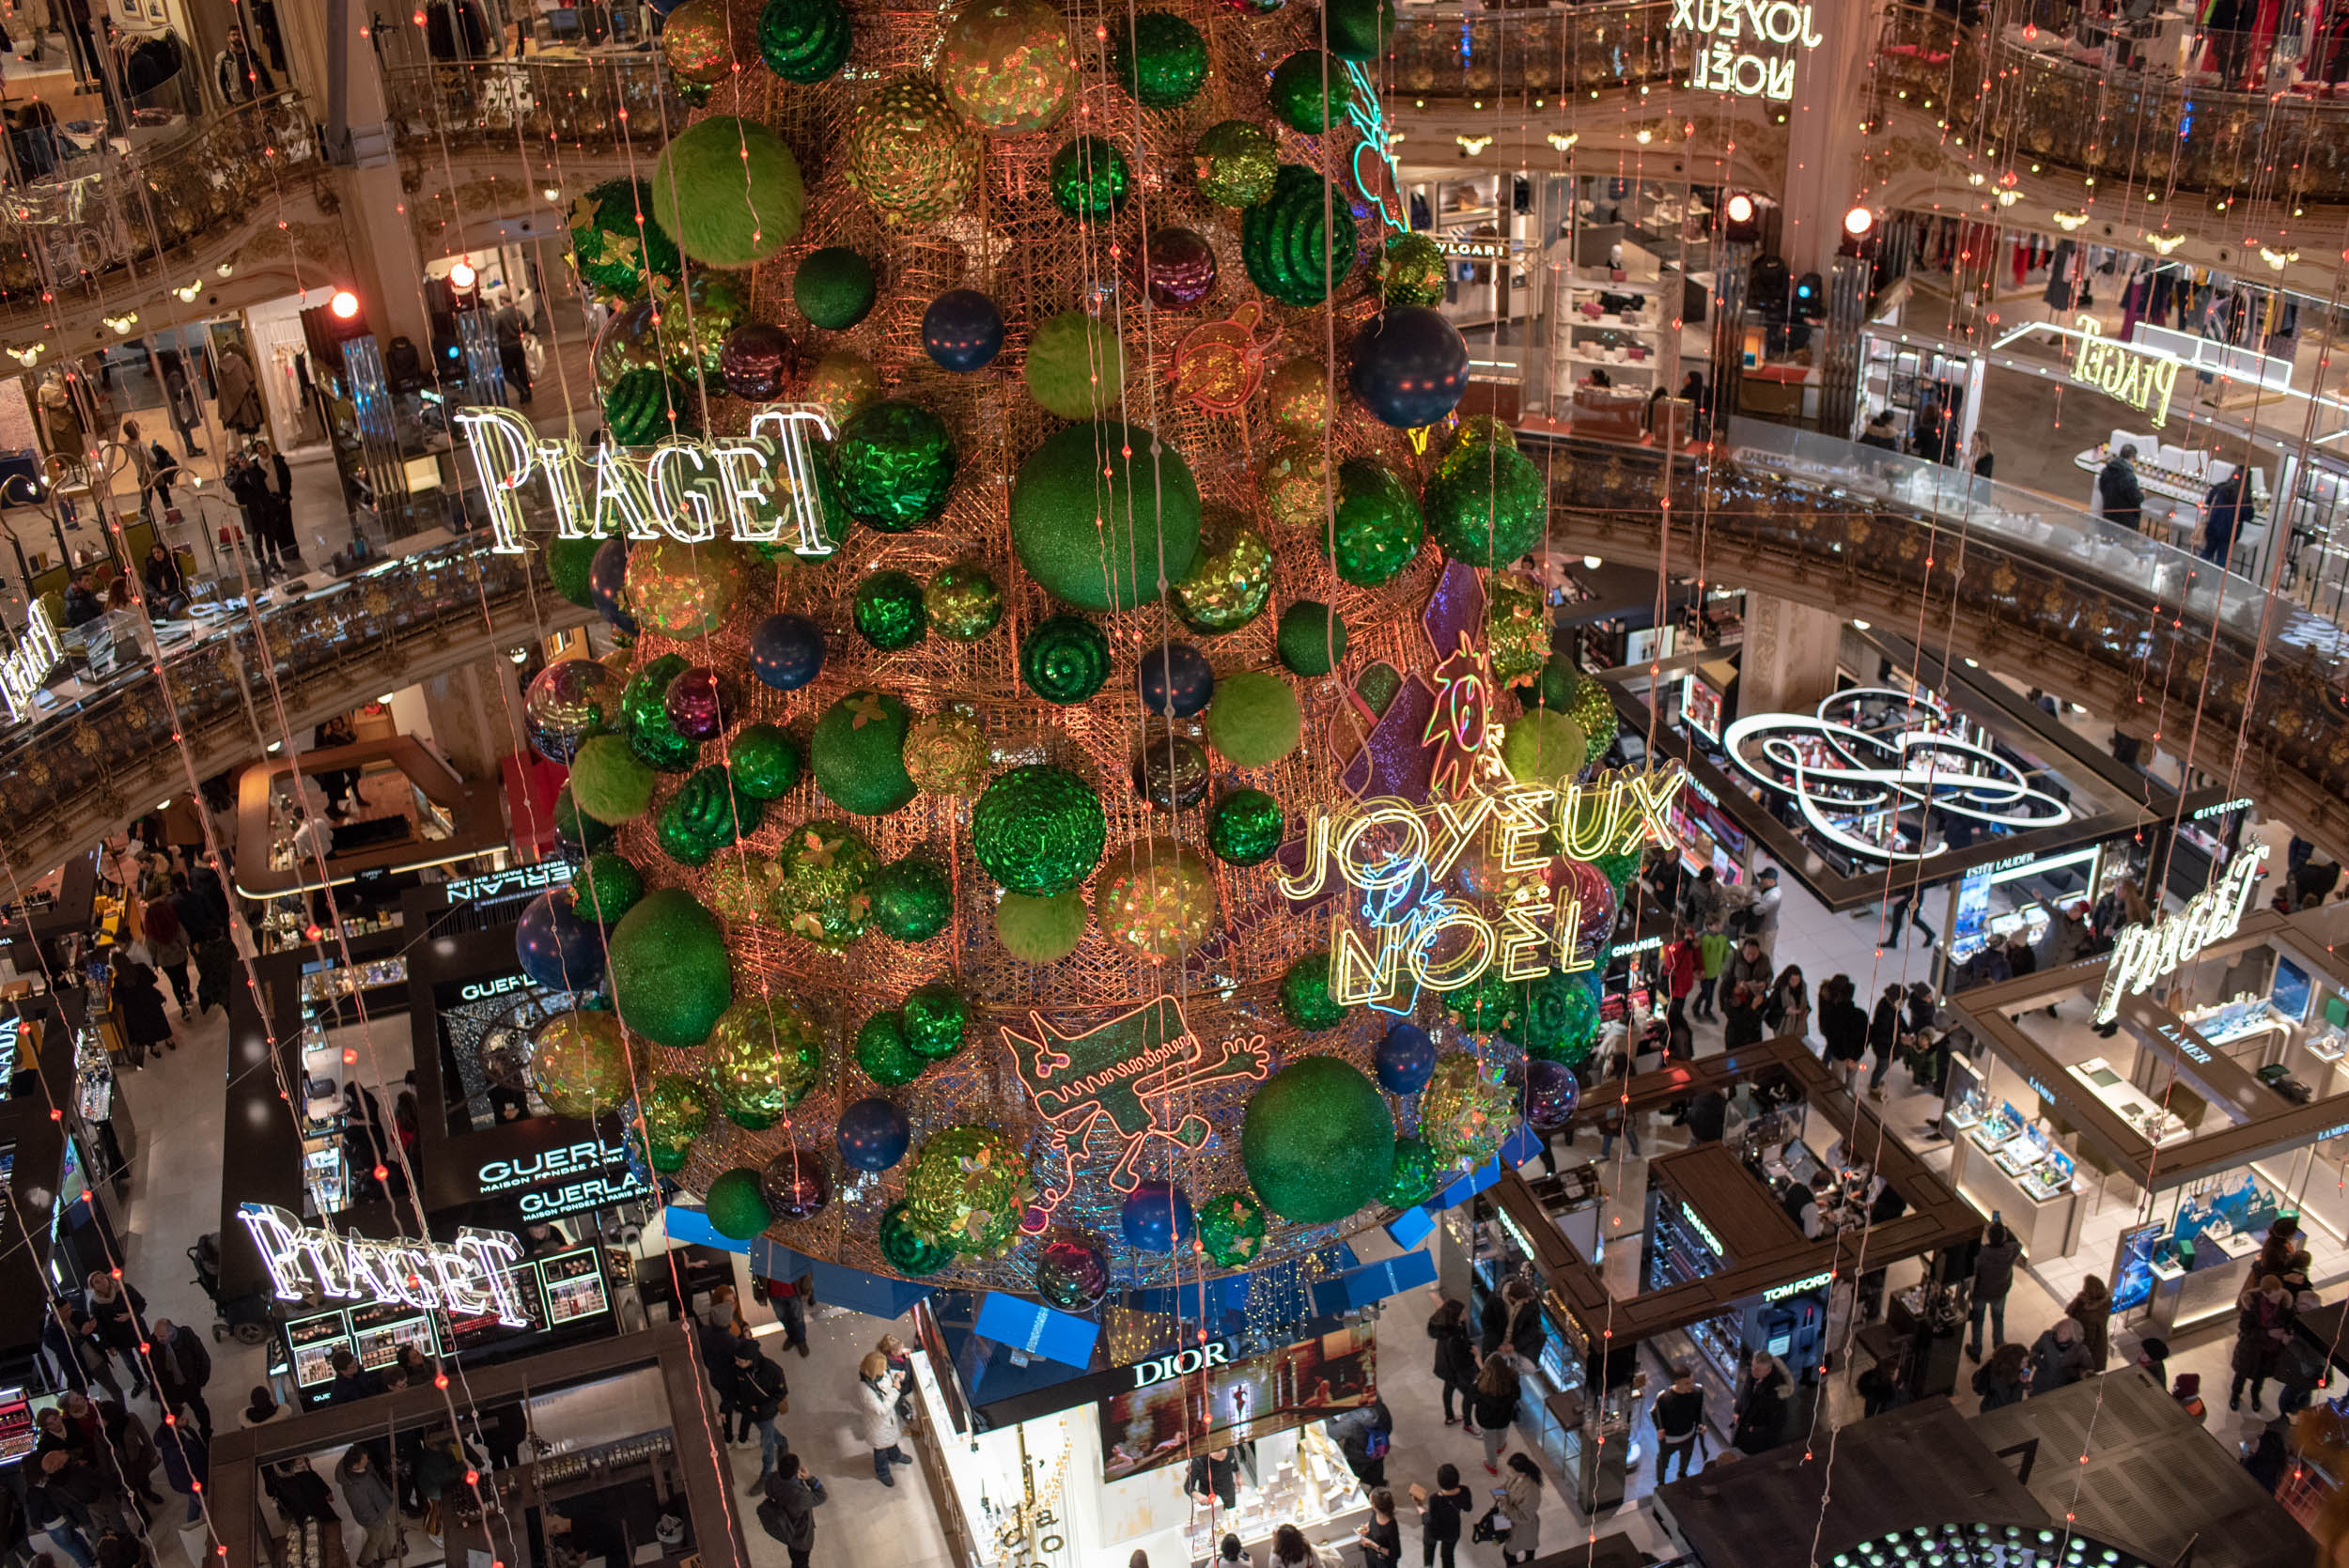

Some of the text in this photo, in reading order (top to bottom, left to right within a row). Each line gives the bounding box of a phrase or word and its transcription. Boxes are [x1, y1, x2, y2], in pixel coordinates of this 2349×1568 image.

[1436, 241, 1503, 256] VLGARI
[453, 410, 833, 556] PIAGET
[2193, 798, 2254, 820] GIVENCH
[1278, 770, 1688, 901] JOYEUX
[446, 865, 578, 904] ERLAIN
[1337, 884, 1595, 1007] NOËL
[1610, 936, 1664, 958] CHANEL
[2095, 844, 2270, 1025] PIAGET
[460, 972, 538, 1001] GUERL
[477, 1139, 625, 1184] GUERL
[479, 1175, 531, 1194] MAISON
[519, 1172, 643, 1213] GUERLA
[521, 1207, 559, 1222] MAISON
[559, 1198, 597, 1214] FONDÉE
[606, 1189, 633, 1202] PARIS
[1497, 1205, 1535, 1261] TOM FORD
[1682, 1201, 1724, 1257] TOM FORD
[236, 1209, 528, 1328] PIAGET
[1763, 1272, 1833, 1303] TOM FORD
[1132, 1342, 1229, 1389] DIOR
